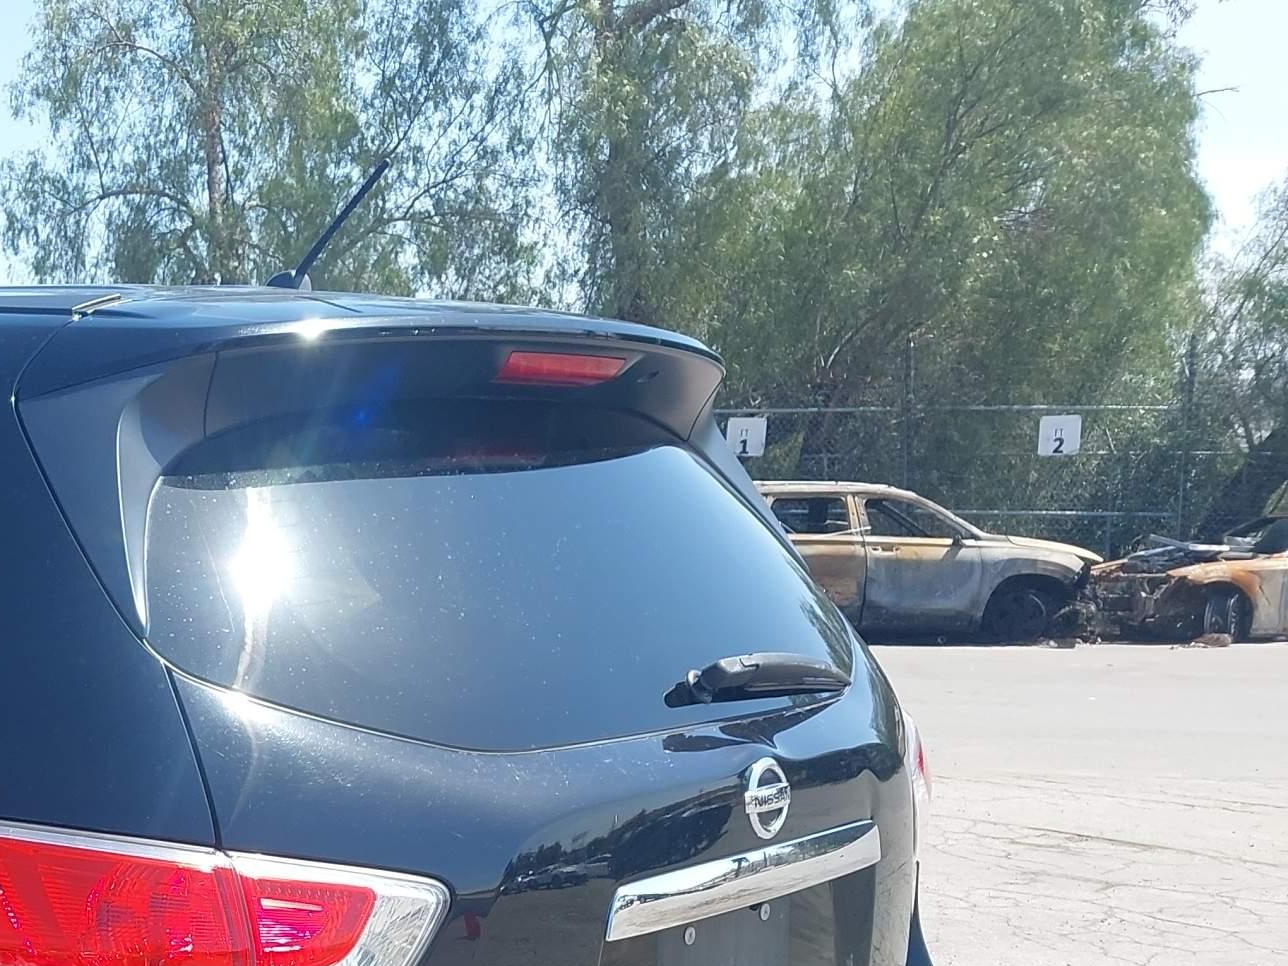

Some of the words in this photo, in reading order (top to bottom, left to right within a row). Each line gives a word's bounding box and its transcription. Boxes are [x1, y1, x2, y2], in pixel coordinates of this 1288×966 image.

[739, 438, 749, 454] 1
[1052, 437, 1065, 454] 2
[751, 786, 790, 808] NISSAN
